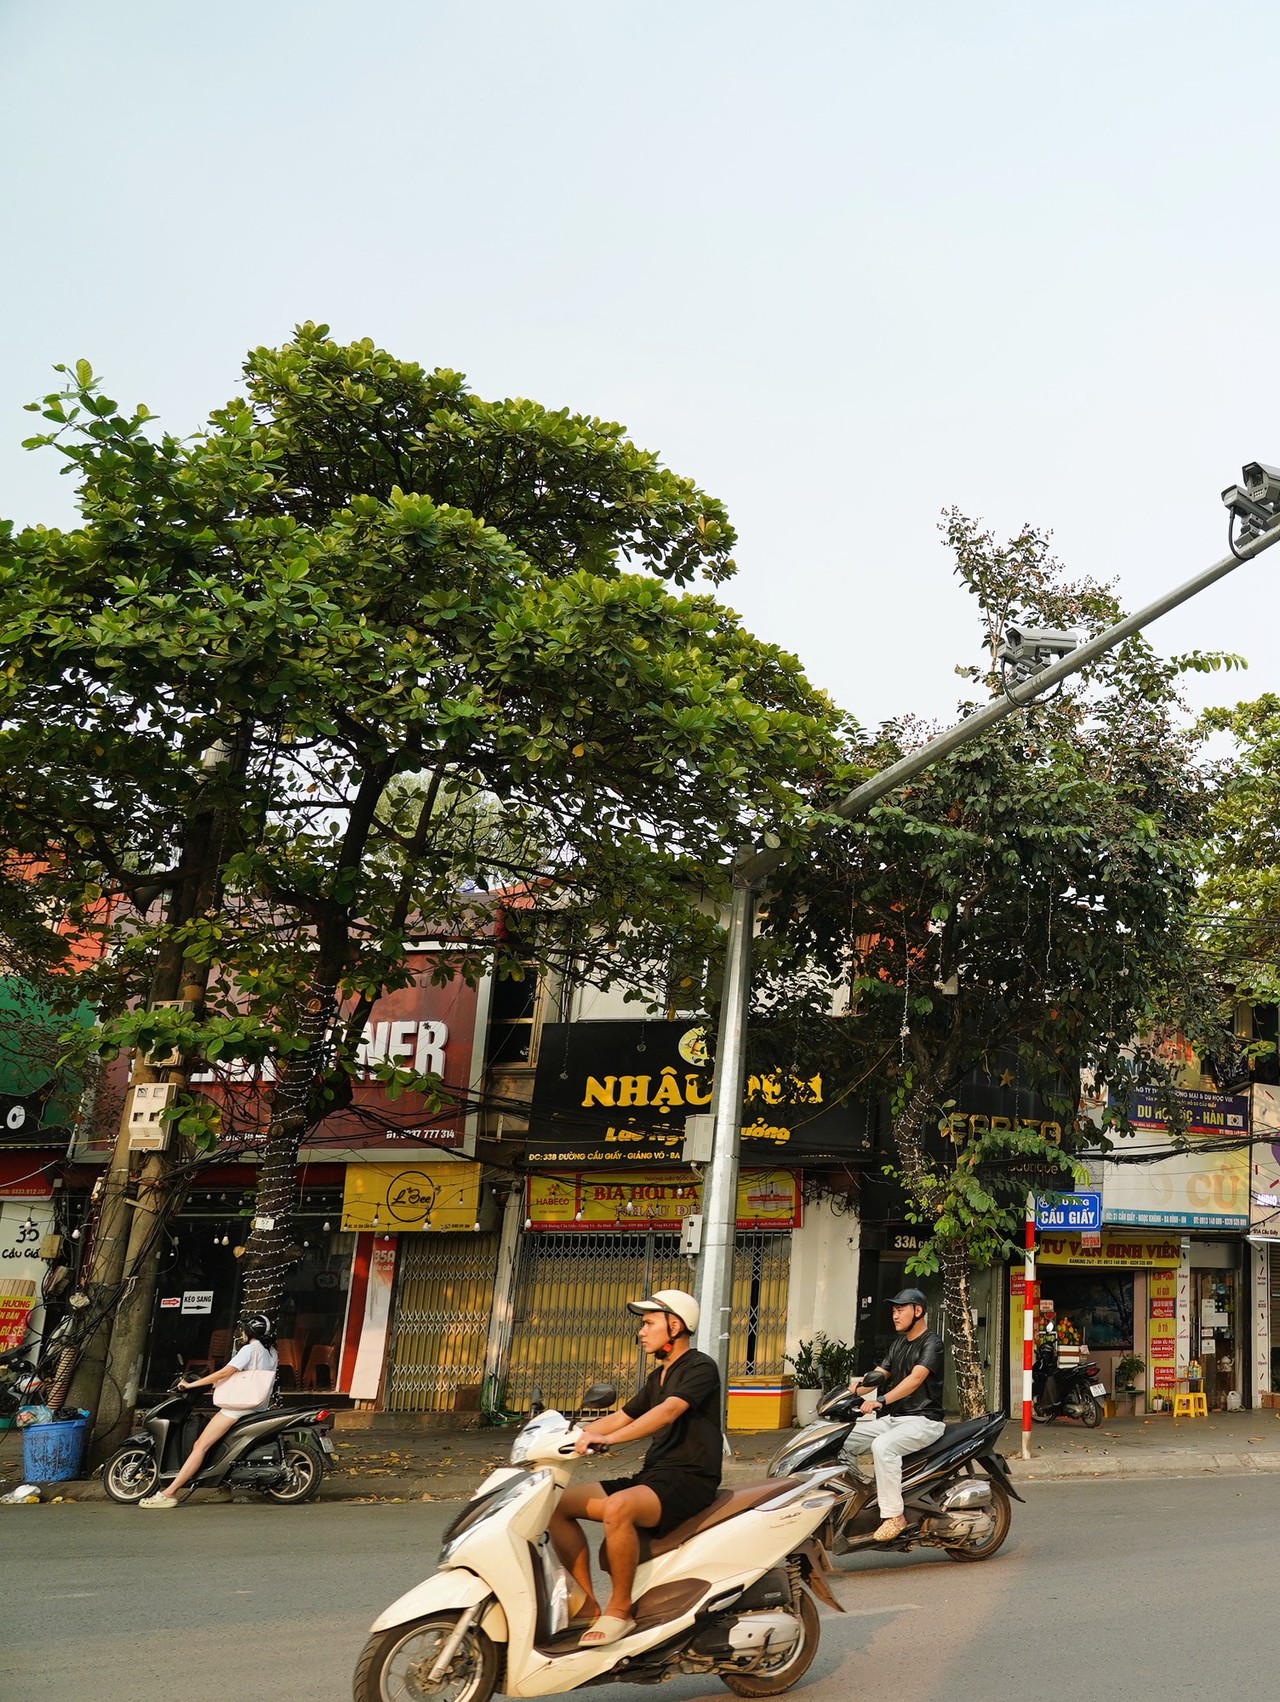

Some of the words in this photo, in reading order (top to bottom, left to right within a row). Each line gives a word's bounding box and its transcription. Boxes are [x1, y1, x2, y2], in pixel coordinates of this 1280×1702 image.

[1137, 1104, 1152, 1119] DU
[1202, 1108, 1224, 1126] HÀN
[423, 1129, 440, 1139] 777
[441, 1129, 455, 1139] 314
[558, 1151, 586, 1161] ĐƯỜNG
[587, 1150, 603, 1161] CẦU
[604, 1149, 622, 1161] GIẤY
[627, 1151, 652, 1160] GIẢNG
[594, 1186, 625, 1201] BIA
[1186, 1164, 1240, 1210] CŨ
[536, 1198, 570, 1206] HABECO
[1041, 1208, 1064, 1224] CẦU
[1069, 1207, 1095, 1224] GIẤY
[894, 1235, 917, 1248] 33A
[1041, 1238, 1067, 1255] TƯ
[1106, 1243, 1144, 1259] SINH
[1146, 1240, 1181, 1259] VIÊN
[2, 1247, 22, 1259] Cầu
[24, 1246, 42, 1260] Giấ
[184, 1294, 195, 1303] KÉO
[196, 1295, 212, 1303] SANG
